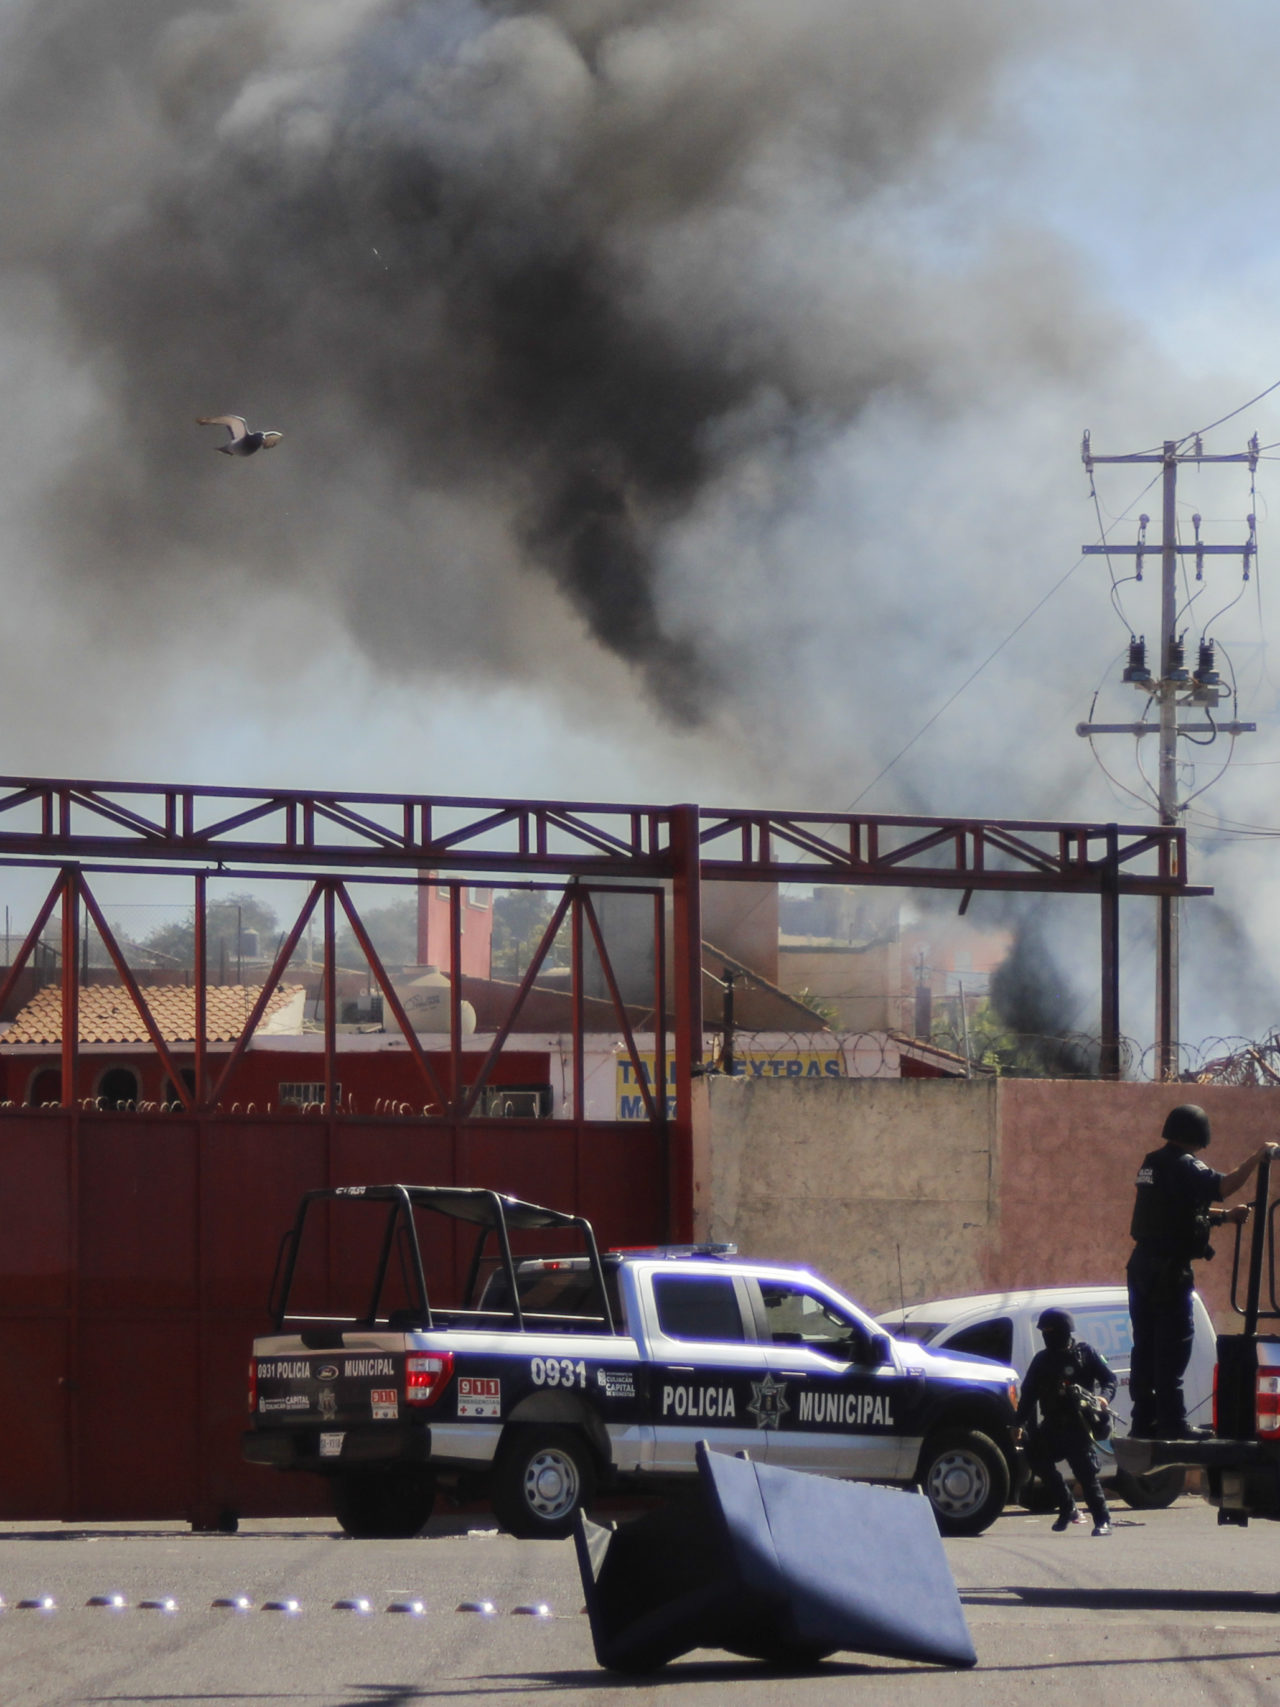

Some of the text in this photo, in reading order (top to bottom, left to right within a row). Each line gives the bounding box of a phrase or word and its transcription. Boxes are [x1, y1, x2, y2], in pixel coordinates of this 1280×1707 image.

[257, 1361, 311, 1379] 0931 POLICIA
[344, 1359, 395, 1377] MUNICIPAL
[531, 1357, 586, 1388] 0931
[461, 1380, 497, 1394] 911
[606, 1383, 636, 1392] CAPITAL
[374, 1391, 396, 1402] 911
[662, 1384, 894, 1426] POLICIA MUNICIPAL
